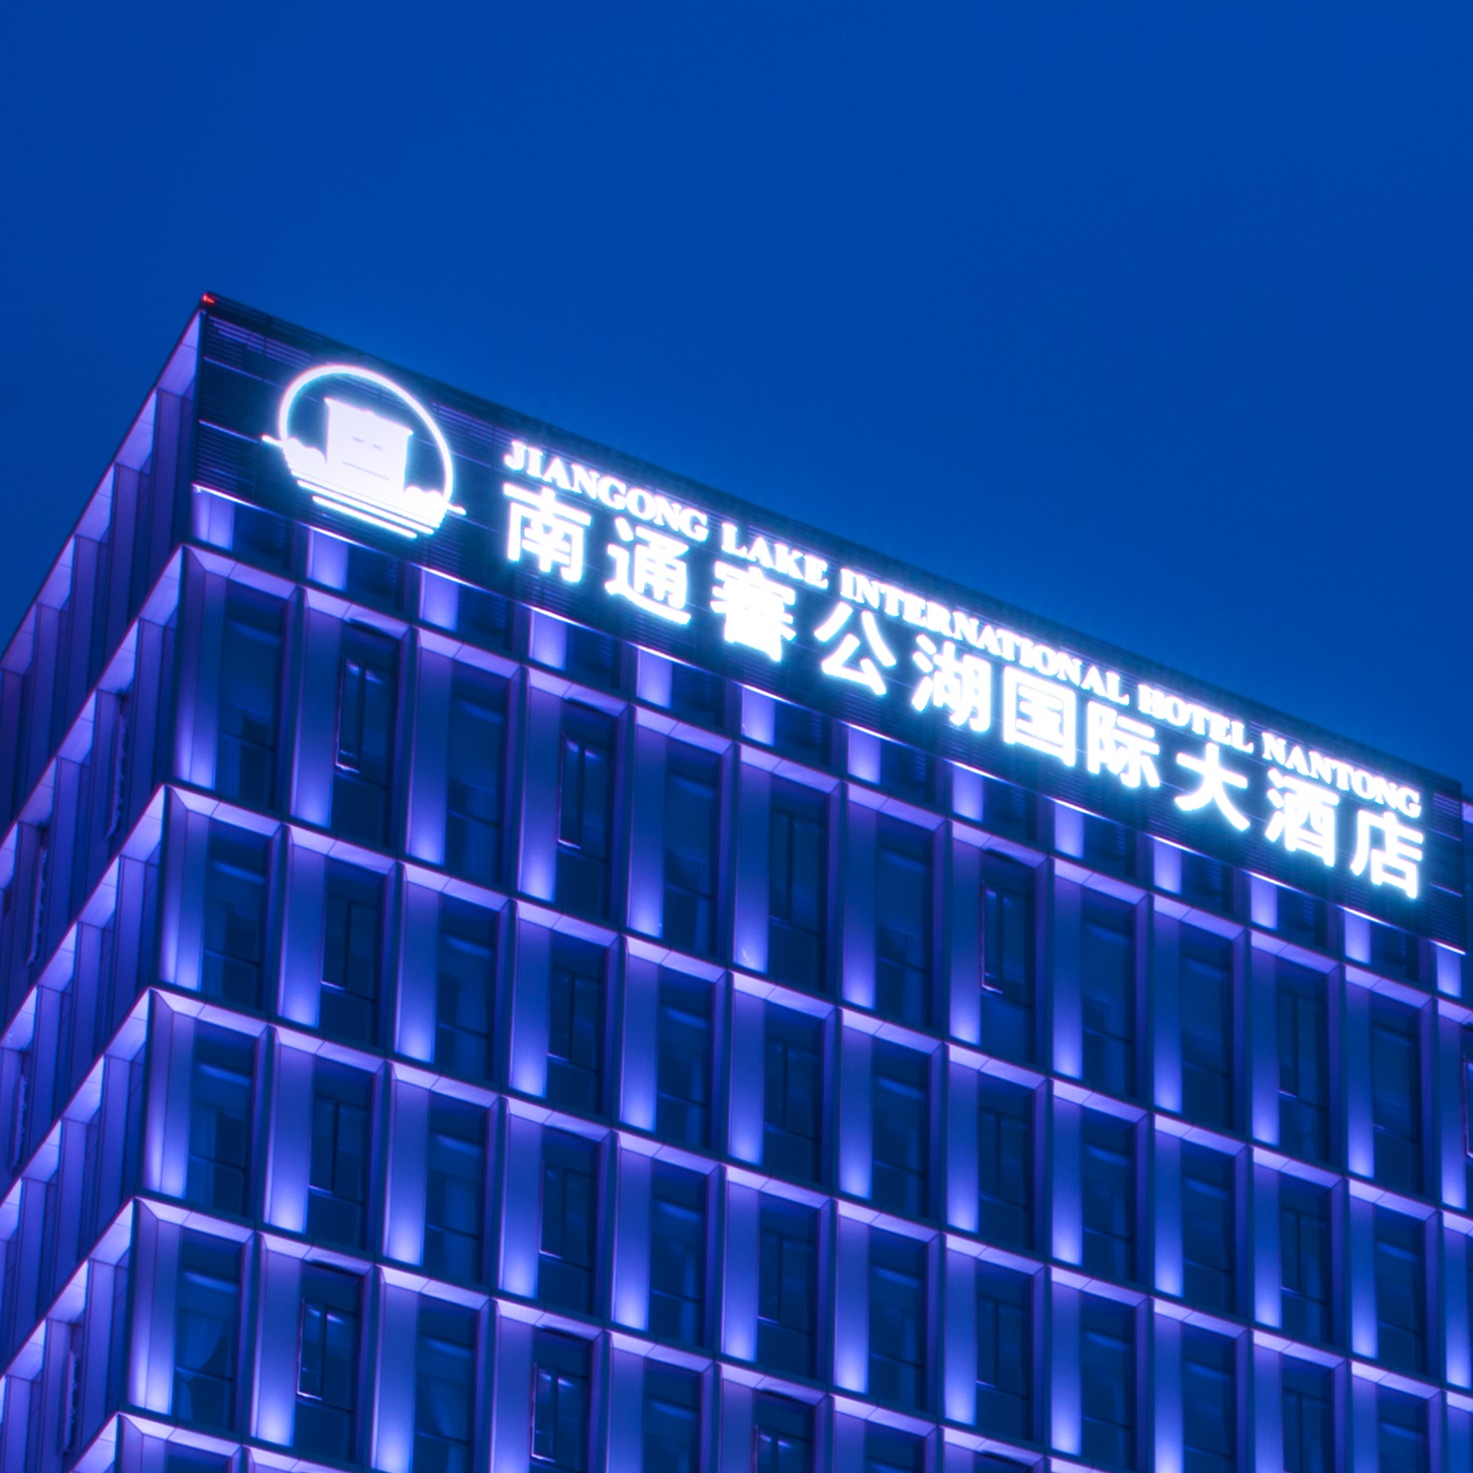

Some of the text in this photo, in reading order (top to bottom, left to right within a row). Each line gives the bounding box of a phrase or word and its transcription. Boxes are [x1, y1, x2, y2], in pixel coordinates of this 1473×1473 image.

[502, 438, 1422, 819] JIANGONG LAKE INTERNATIONAL HOTEL NANTONG
